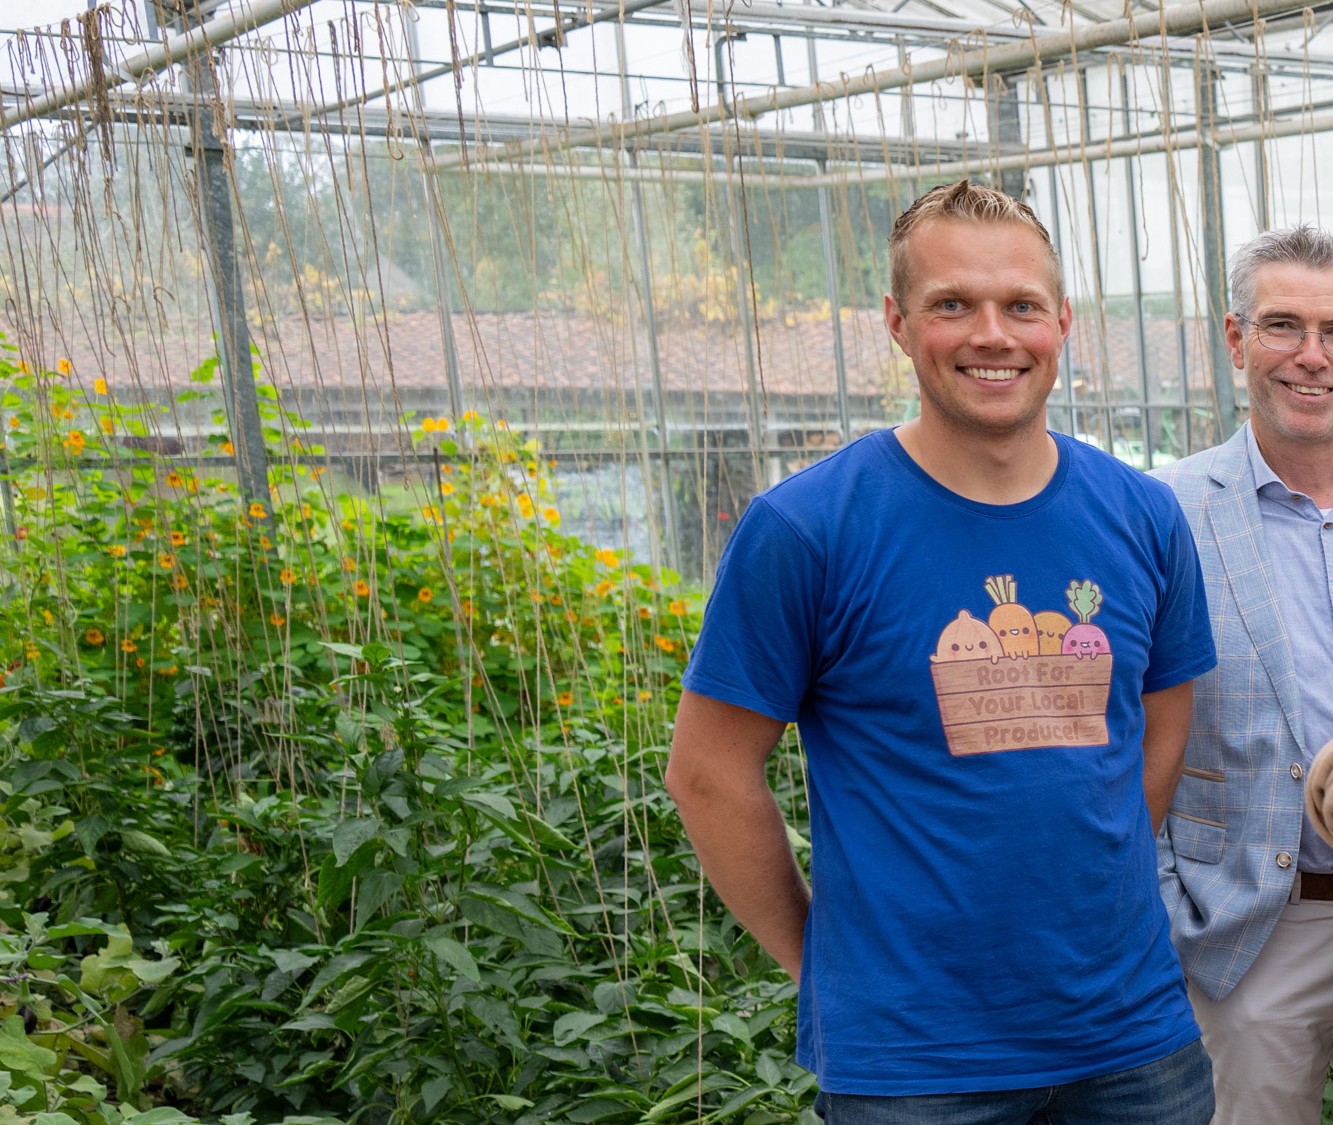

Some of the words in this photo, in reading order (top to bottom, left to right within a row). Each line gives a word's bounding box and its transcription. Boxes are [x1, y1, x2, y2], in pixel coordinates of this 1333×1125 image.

[977, 665, 1030, 685] Root
[1036, 663, 1075, 682] For
[968, 694, 1025, 715] Your
[1031, 690, 1085, 711] Local
[983, 721, 1079, 745] Produce!
